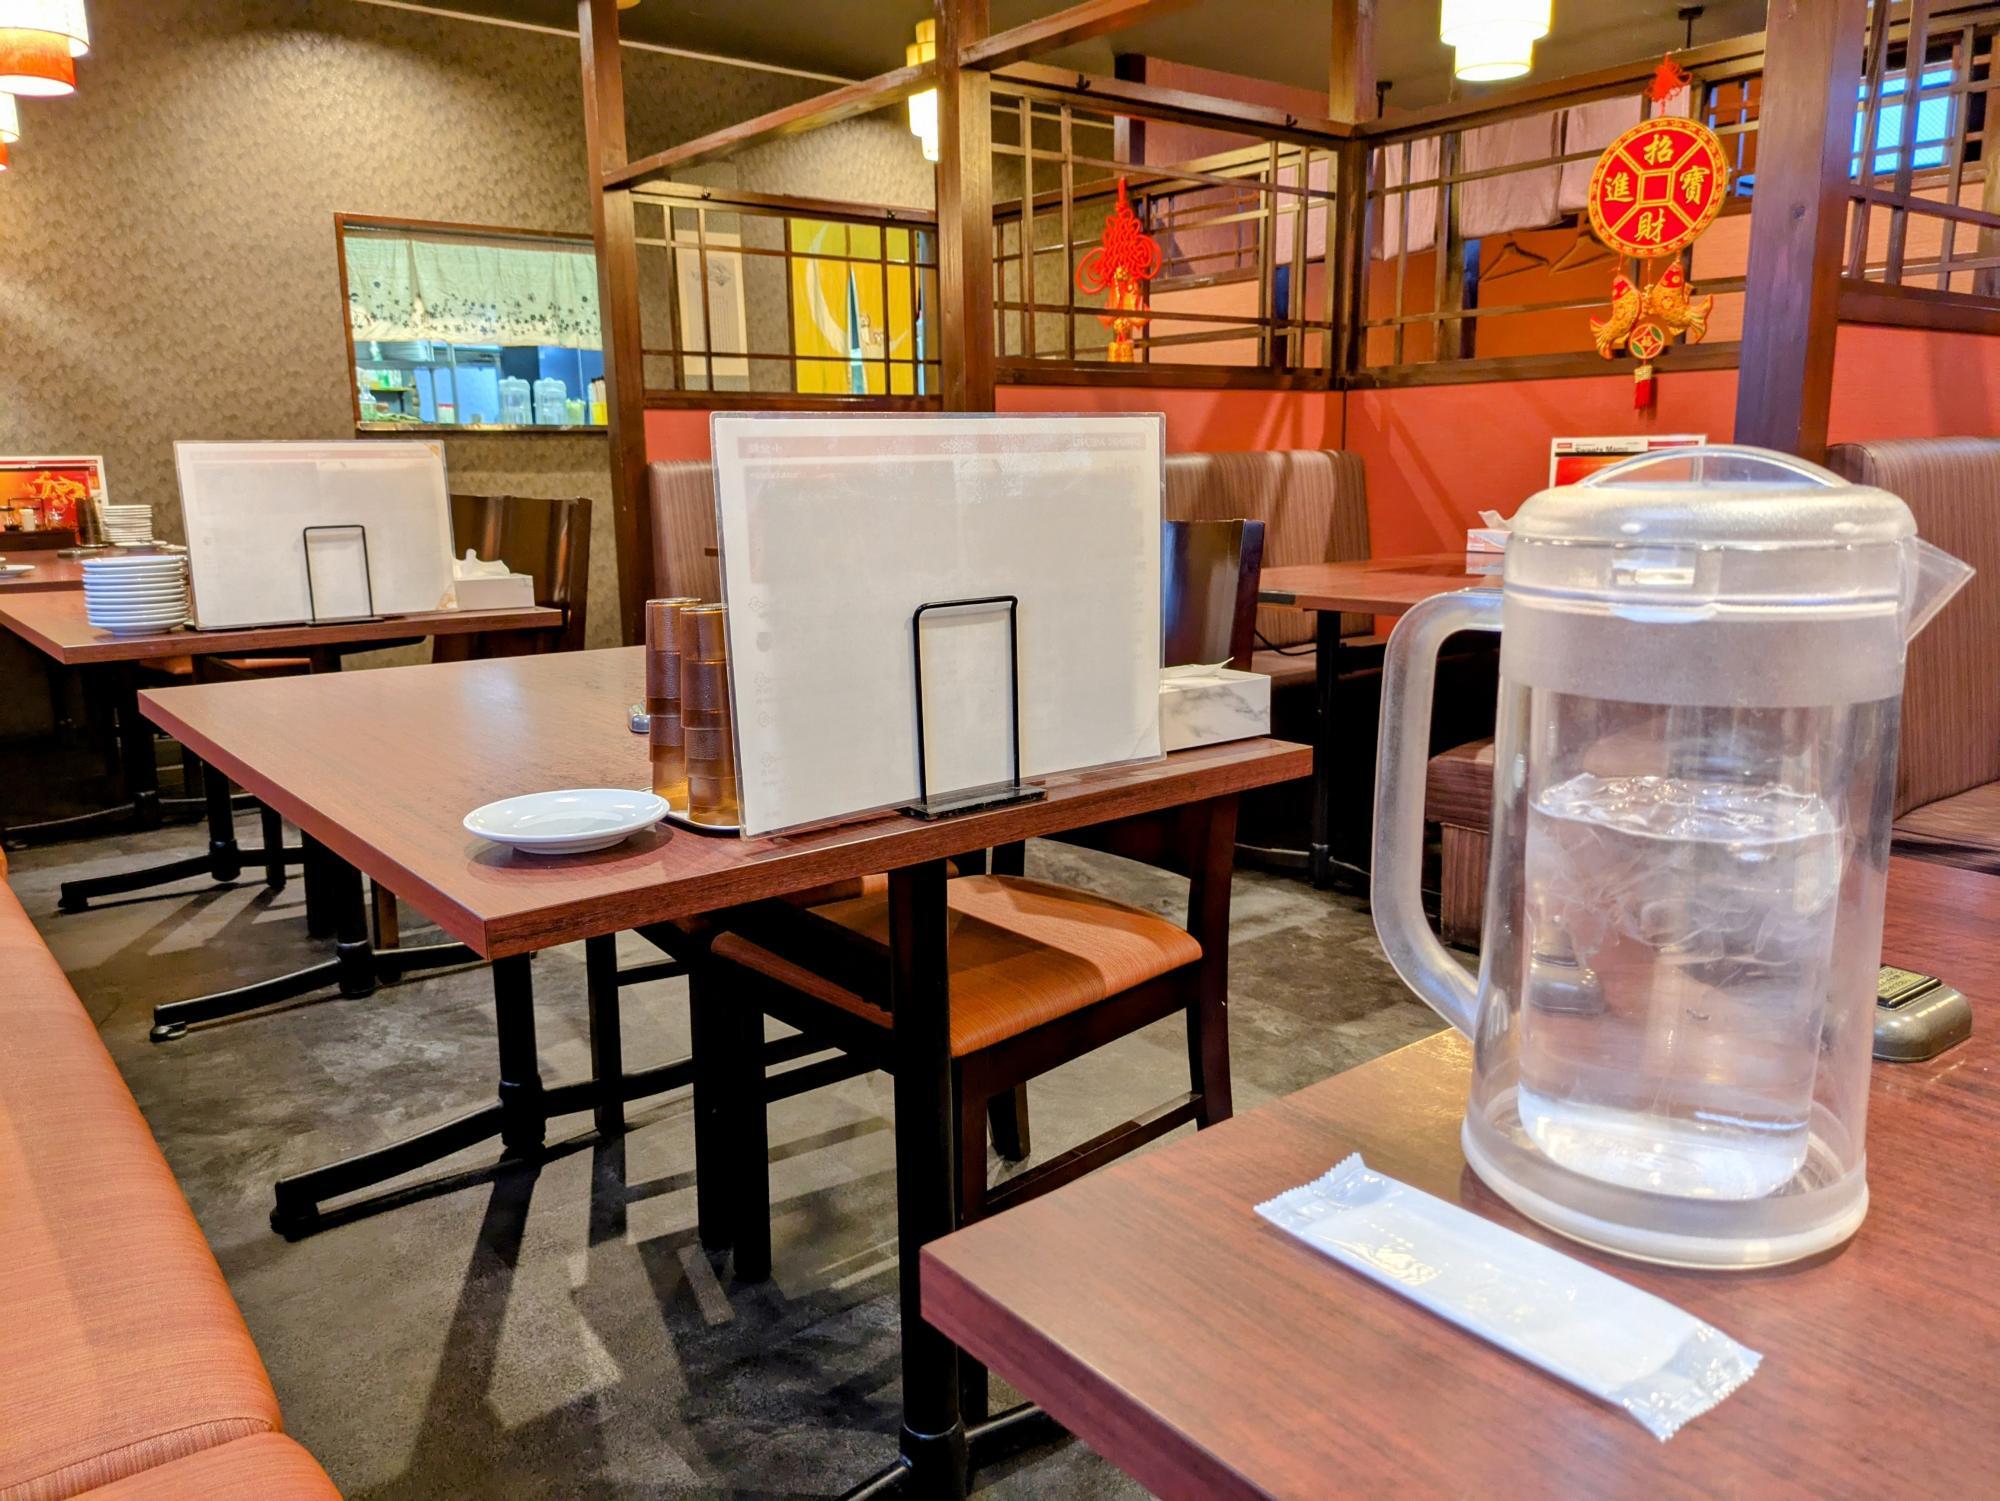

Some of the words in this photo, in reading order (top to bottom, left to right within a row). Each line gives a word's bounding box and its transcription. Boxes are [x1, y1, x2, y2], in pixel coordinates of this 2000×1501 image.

[1643, 134, 1673, 165] 招
[1604, 172, 1633, 202] 進
[1679, 165, 1710, 204] 寶
[1634, 207, 1666, 243] 財
